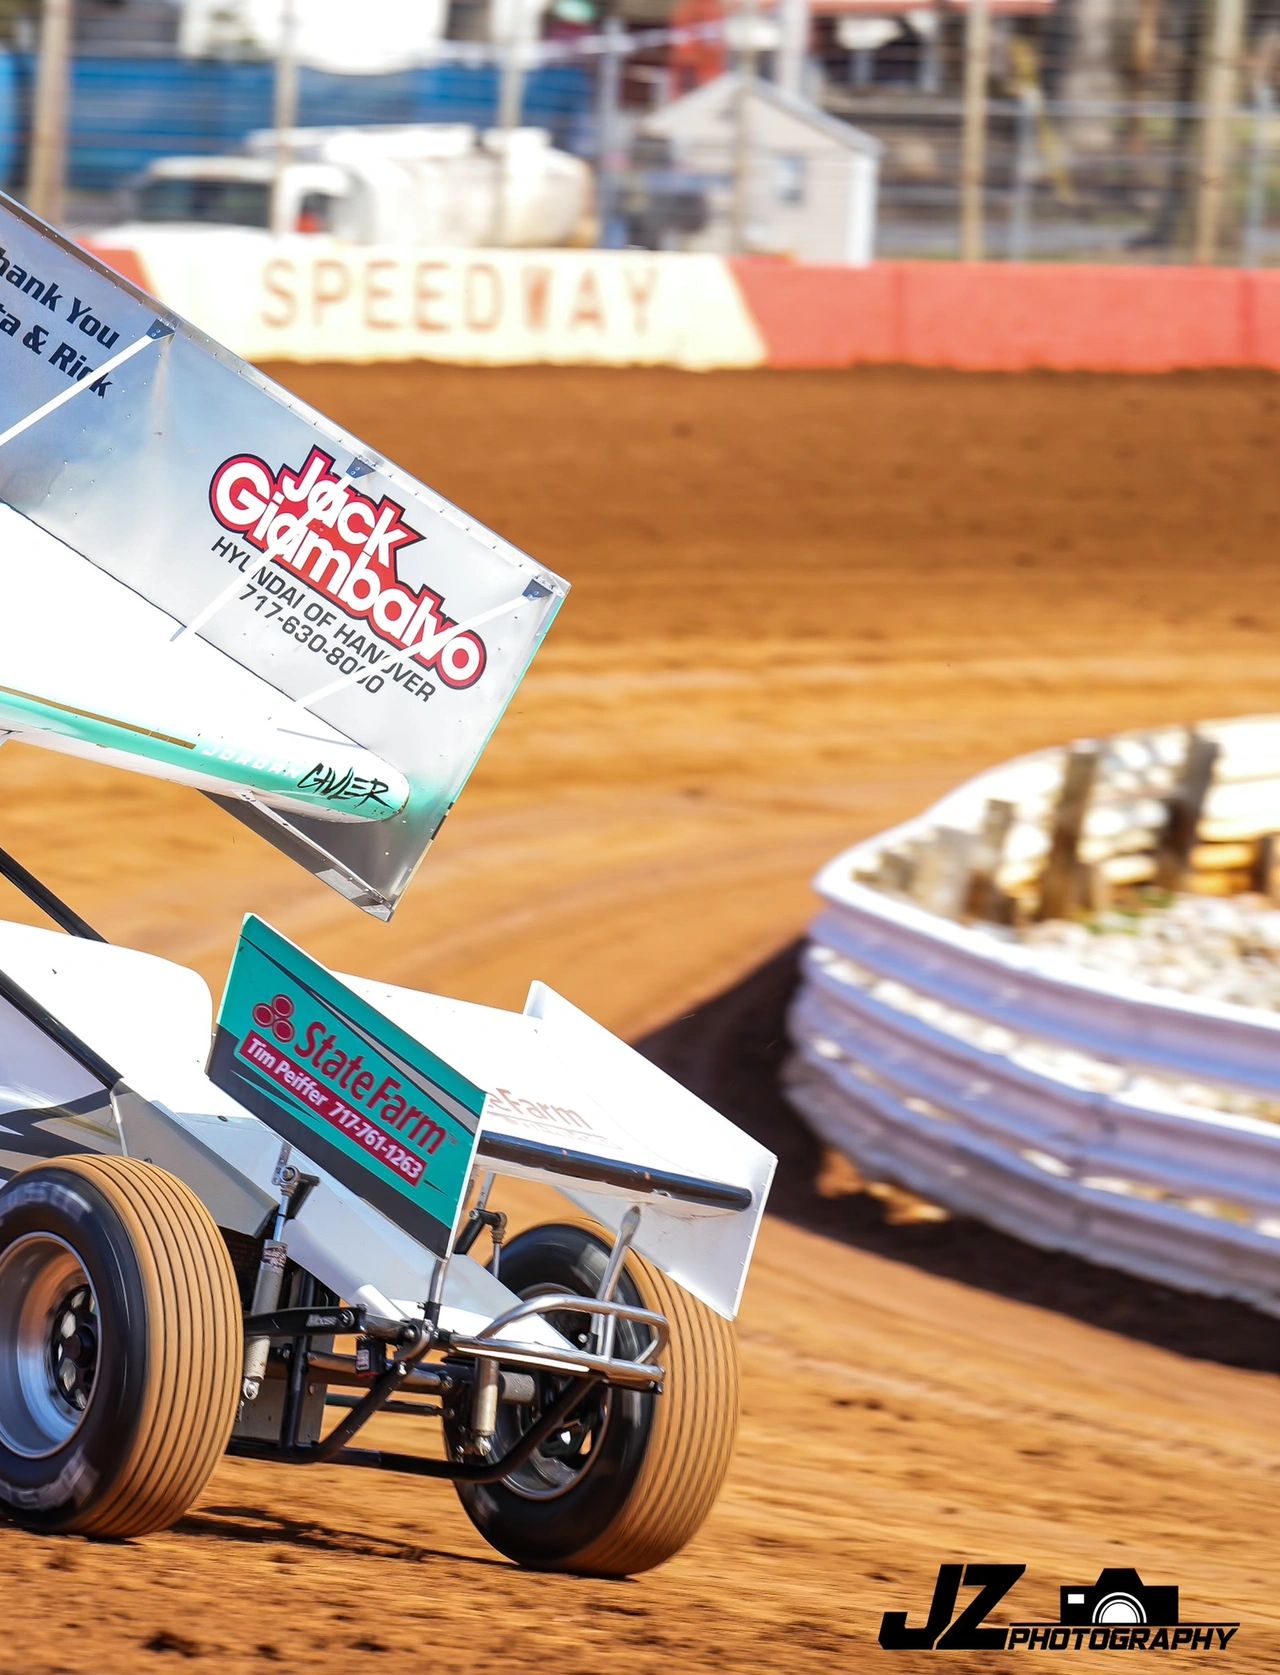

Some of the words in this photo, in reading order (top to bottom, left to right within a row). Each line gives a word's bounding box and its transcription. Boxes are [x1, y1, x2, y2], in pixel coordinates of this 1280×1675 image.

[66, 296, 120, 350] You
[260, 258, 659, 334] SPEEDWAY
[22, 324, 50, 355] &
[280, 454, 409, 569] Jack
[303, 601, 337, 626] OF
[246, 1036, 277, 1069] Tim
[274, 1057, 329, 1107] Peiffer
[328, 1101, 422, 1179] 717-761-1263
